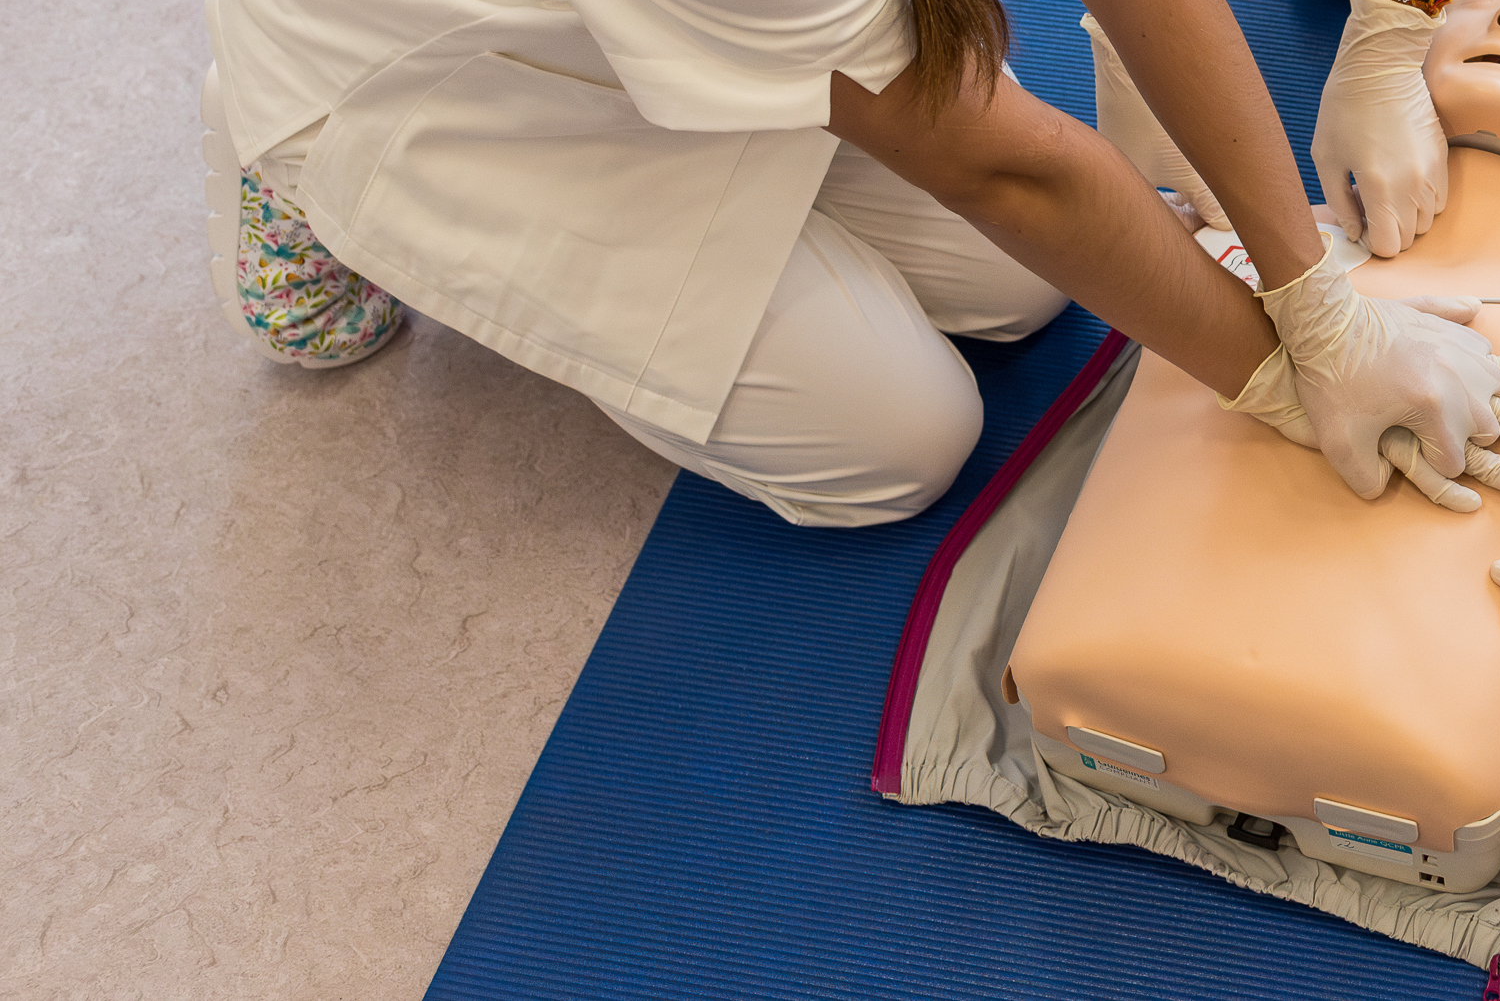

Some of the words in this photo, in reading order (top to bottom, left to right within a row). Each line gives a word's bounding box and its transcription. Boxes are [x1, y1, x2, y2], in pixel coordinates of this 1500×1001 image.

[1334, 830, 1356, 840] Little
[1356, 835, 1378, 845] Anne
[1380, 839, 1406, 851] QCPR
